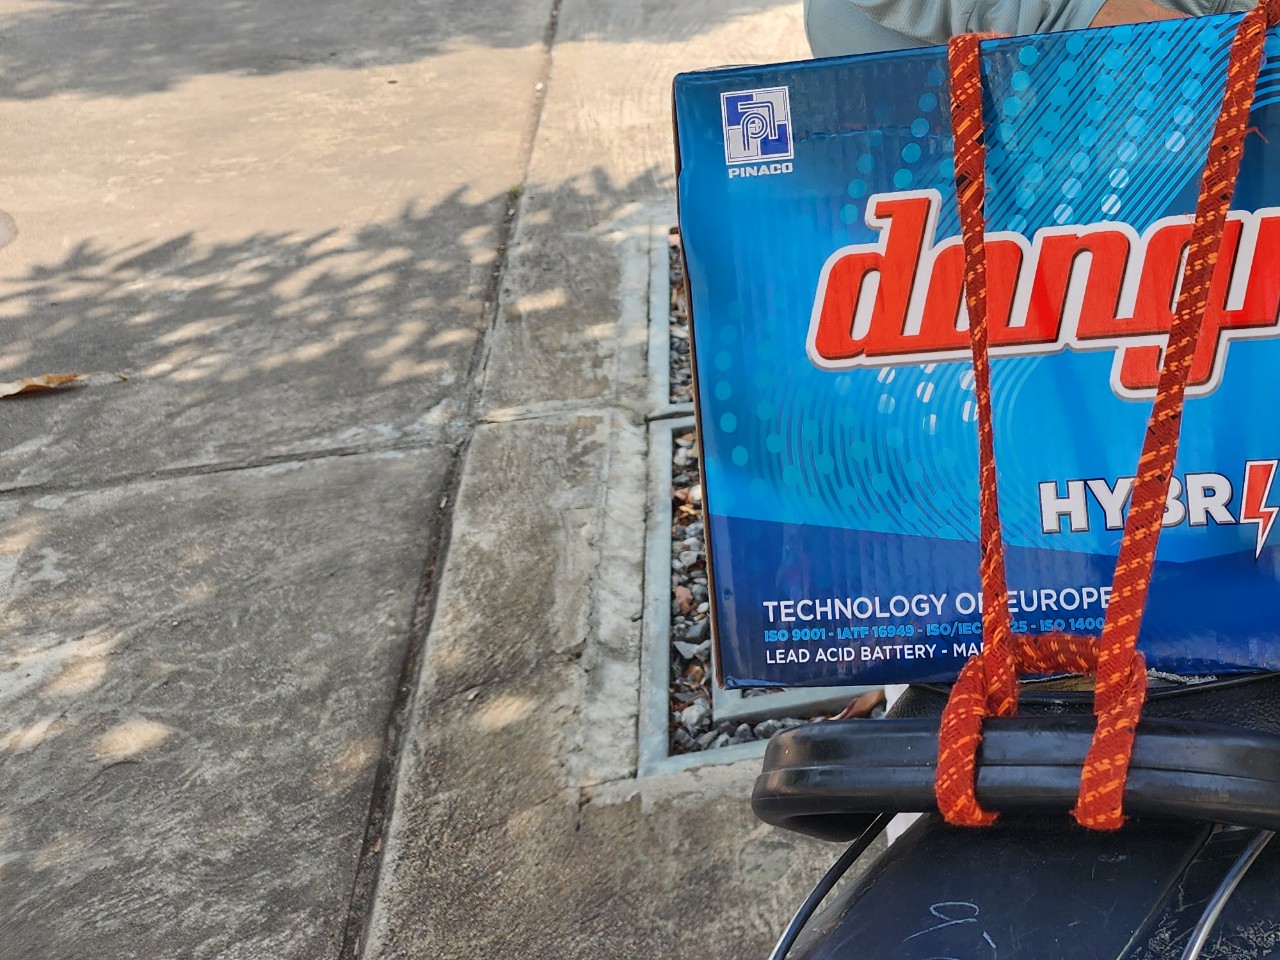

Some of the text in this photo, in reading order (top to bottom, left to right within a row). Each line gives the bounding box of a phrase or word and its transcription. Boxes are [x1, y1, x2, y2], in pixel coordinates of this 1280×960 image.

[728, 162, 794, 179] PINACO
[762, 593, 948, 623] TECHNOLOGY
[764, 629, 789, 643] ISO
[792, 627, 826, 641] 9001
[837, 625, 870, 640] IATF
[872, 623, 915, 638] 16949
[926, 621, 982, 637] ISO/IEC
[1039, 619, 1066, 632] ISO
[1068, 617, 1106, 631] 1400
[766, 648, 810, 664] LEAD
[815, 646, 856, 662] ACID
[860, 643, 937, 661] BATTERY
